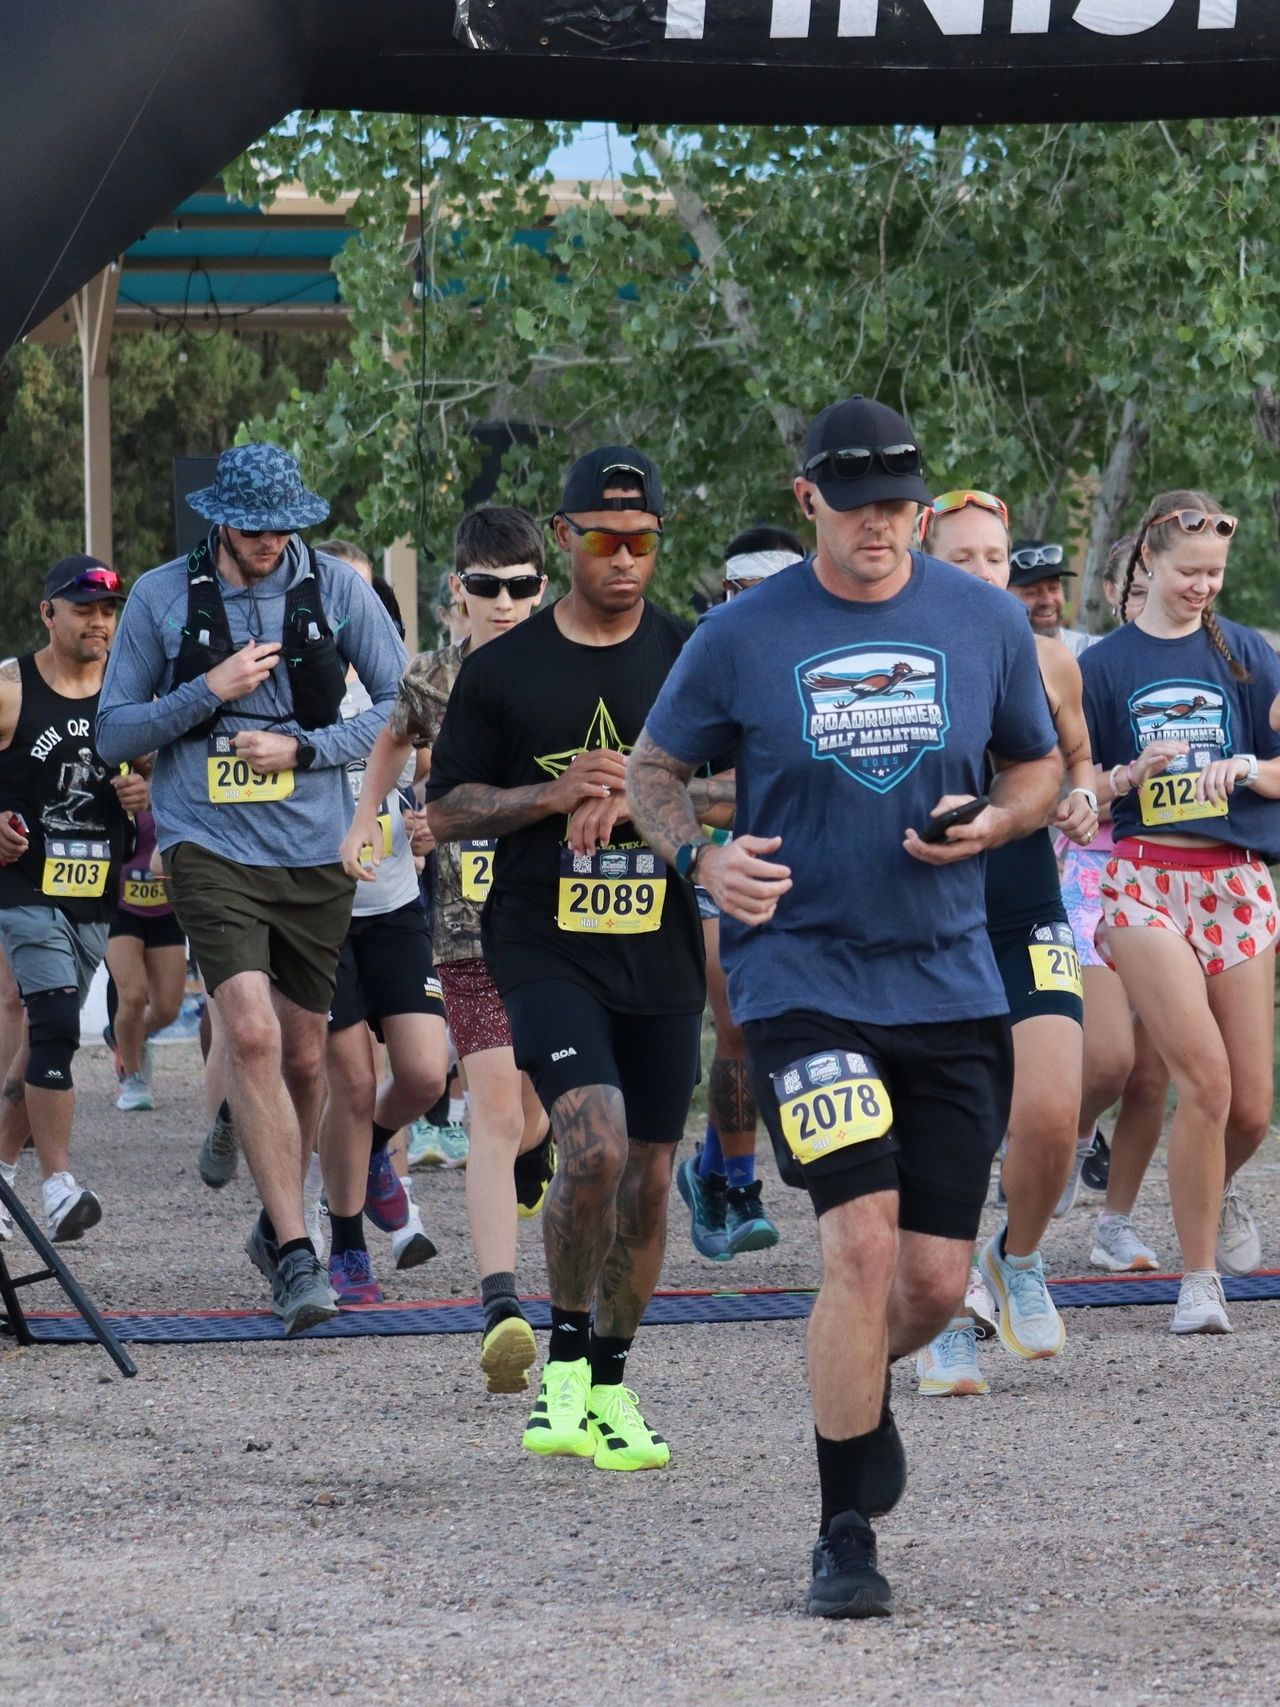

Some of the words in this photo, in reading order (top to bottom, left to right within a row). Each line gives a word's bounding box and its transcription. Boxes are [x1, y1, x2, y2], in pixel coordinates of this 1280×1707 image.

[810, 703, 943, 738] ROADRUNNER
[30, 726, 63, 763] RUN
[67, 718, 90, 737] OR
[818, 731, 855, 751] HALF
[860, 726, 939, 745] MARATHON
[851, 747, 866, 757] RACE
[867, 746, 879, 756] FOR
[880, 745, 891, 755] THE
[891, 743, 908, 754] ARTS
[862, 756, 899, 768] 2025
[1150, 777, 1199, 809] 212
[52, 862, 100, 885] 2103
[569, 883, 655, 915] 2089
[791, 1084, 881, 1141] 2078
